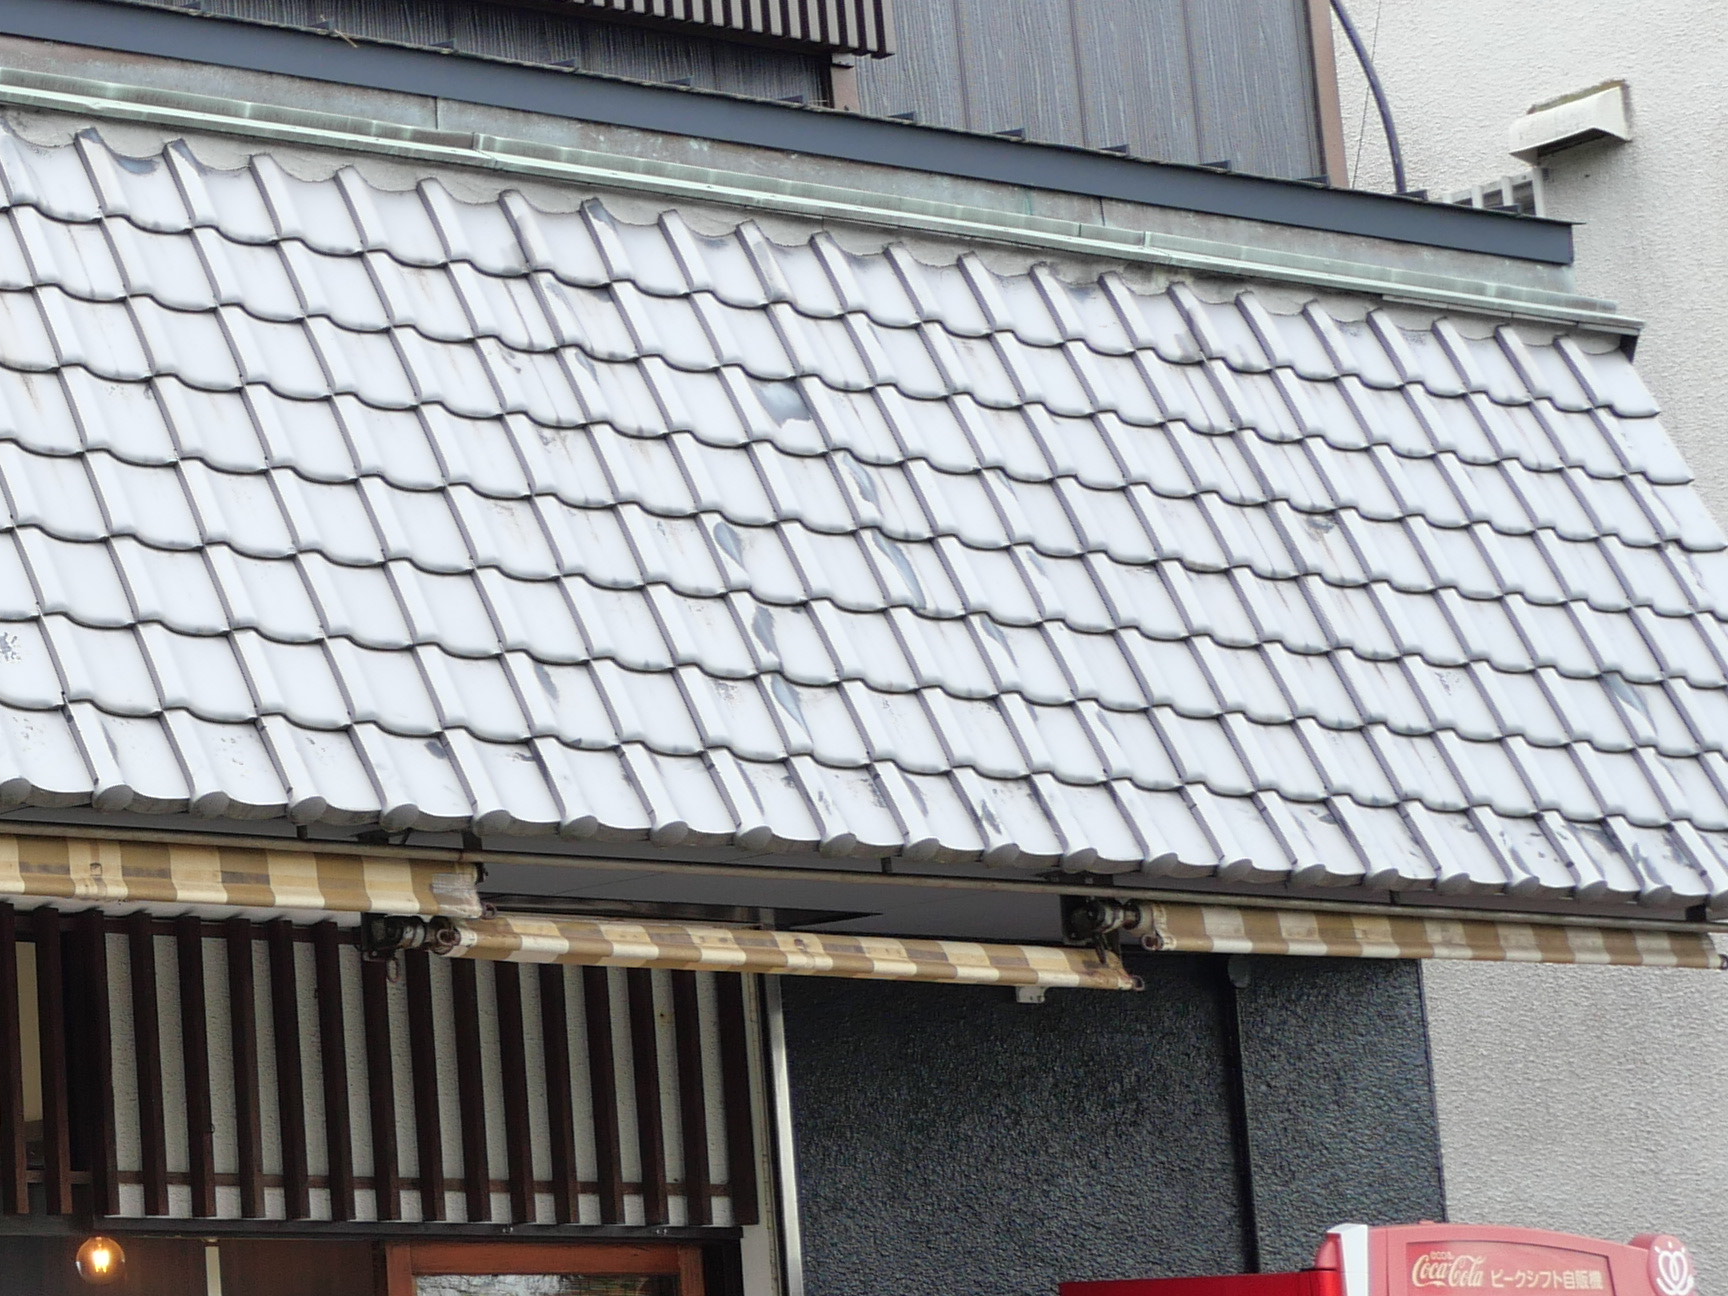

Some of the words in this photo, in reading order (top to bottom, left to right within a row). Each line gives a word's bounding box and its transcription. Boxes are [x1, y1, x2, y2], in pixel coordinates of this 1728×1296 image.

[1411, 1254, 1488, 1288] Coca-Cola
[1490, 1269, 1604, 1290] ピークシフト自販機
